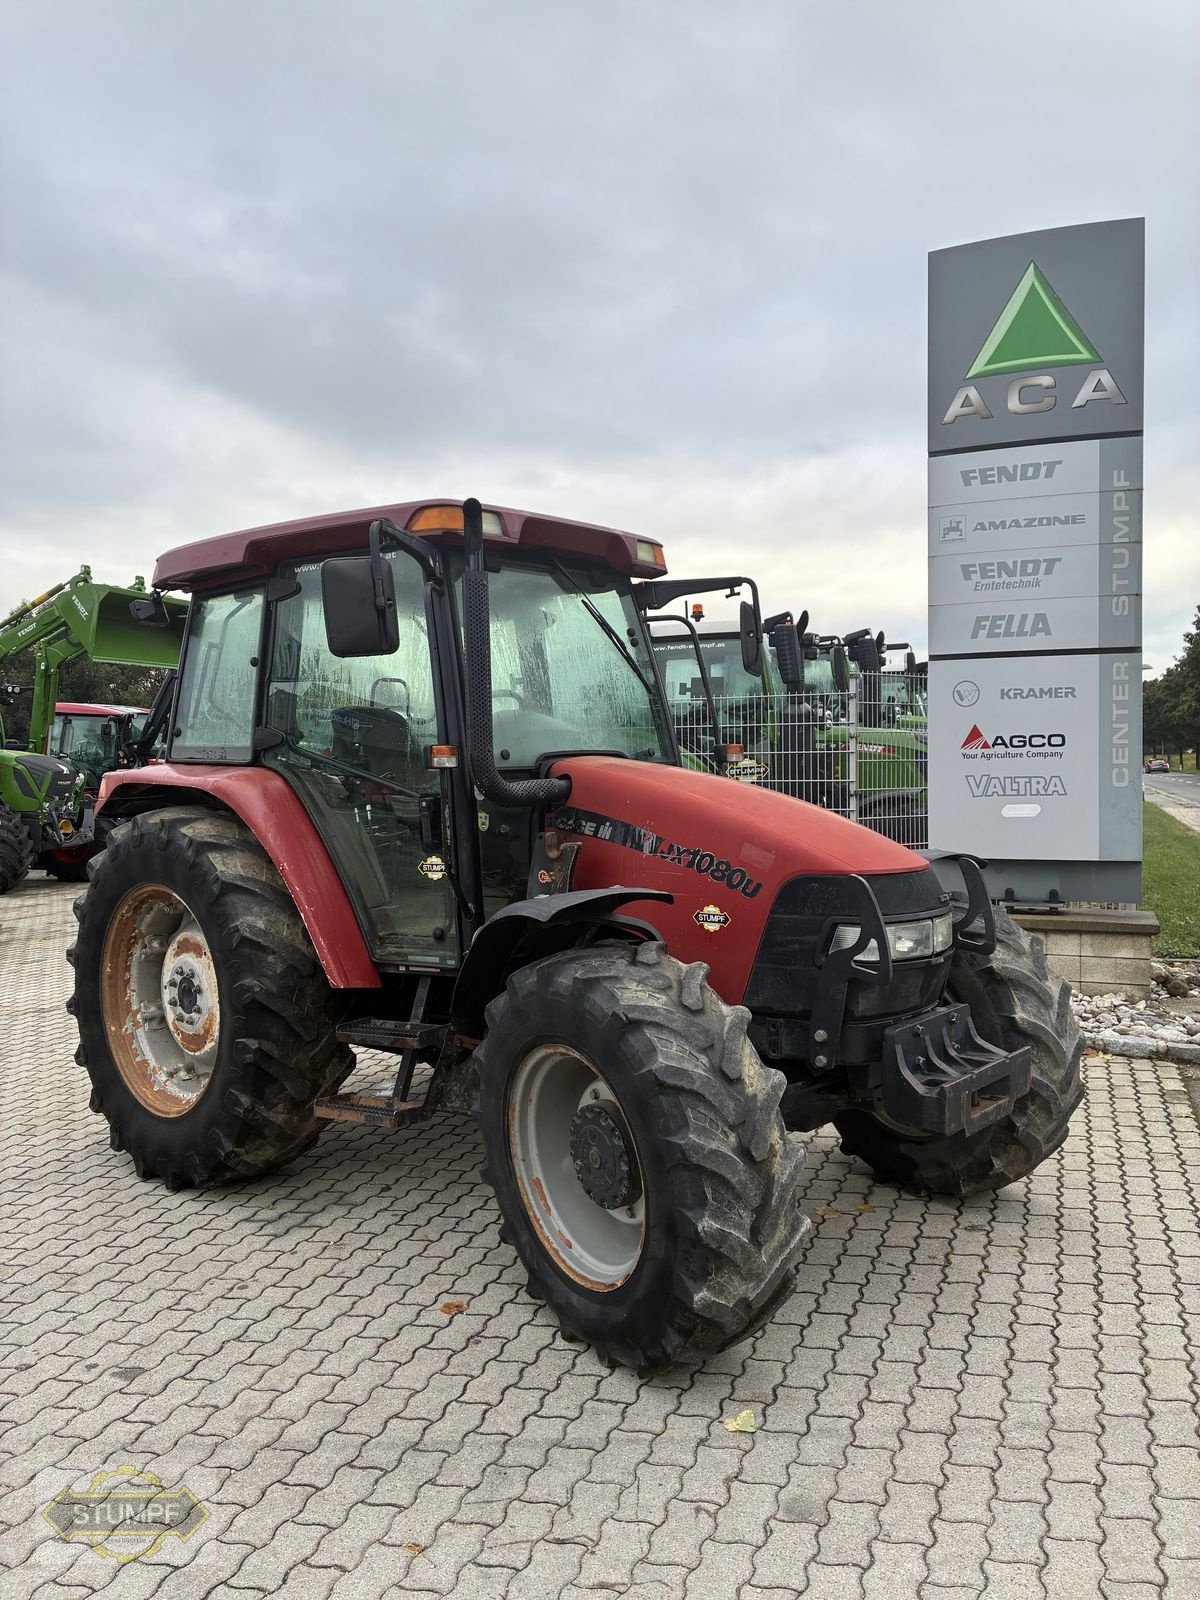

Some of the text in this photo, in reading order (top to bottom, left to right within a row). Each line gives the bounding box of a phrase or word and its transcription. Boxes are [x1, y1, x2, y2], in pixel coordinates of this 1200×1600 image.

[941, 369, 1128, 425] ACA
[960, 460, 1063, 487] FENDT
[973, 514, 1086, 532] AMAZONE
[1112, 470, 1129, 616] STUMPF
[960, 557, 1063, 581] FENDT
[973, 578, 1042, 591] Erntetechnik
[970, 613, 1052, 639] FELLA
[1000, 687, 1077, 699] KRAMER
[1112, 662, 1129, 787] CENTER
[991, 733, 1066, 749] AGCO
[961, 750, 1064, 760] Your Agriculture Company
[965, 774, 1067, 797] VALTRA
[698, 913, 726, 923] STUMPF
